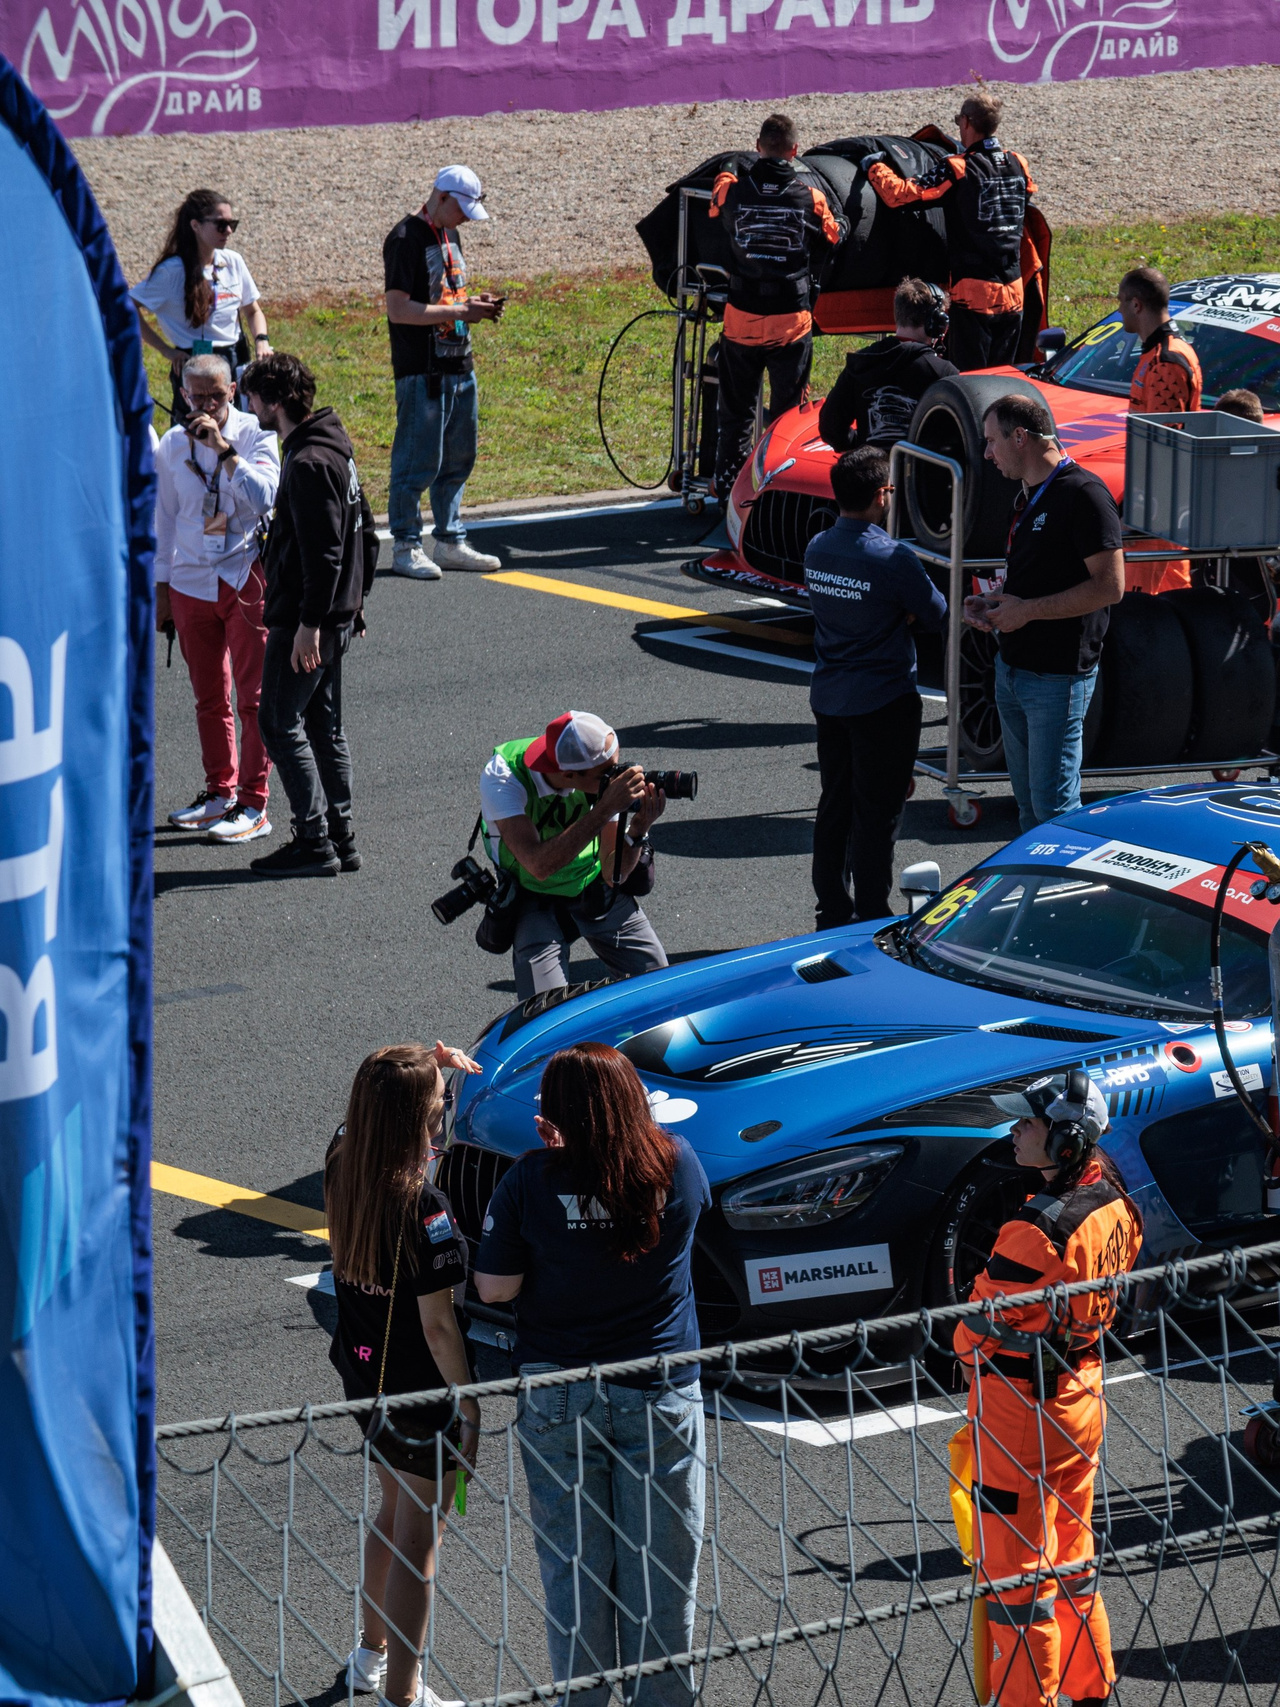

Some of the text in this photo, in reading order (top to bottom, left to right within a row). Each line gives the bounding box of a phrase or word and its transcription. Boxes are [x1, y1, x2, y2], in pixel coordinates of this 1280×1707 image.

[1100, 32, 1179, 60] ДРАЙВ
[164, 83, 262, 115] ДРАЙВ
[805, 568, 872, 592] ТЕХНИЧЕСКАЯ
[1030, 843, 1061, 856] ВТБ
[921, 885, 979, 925] 16
[1200, 876, 1255, 906] auo.ru
[784, 1261, 879, 1285] MARSHALL
